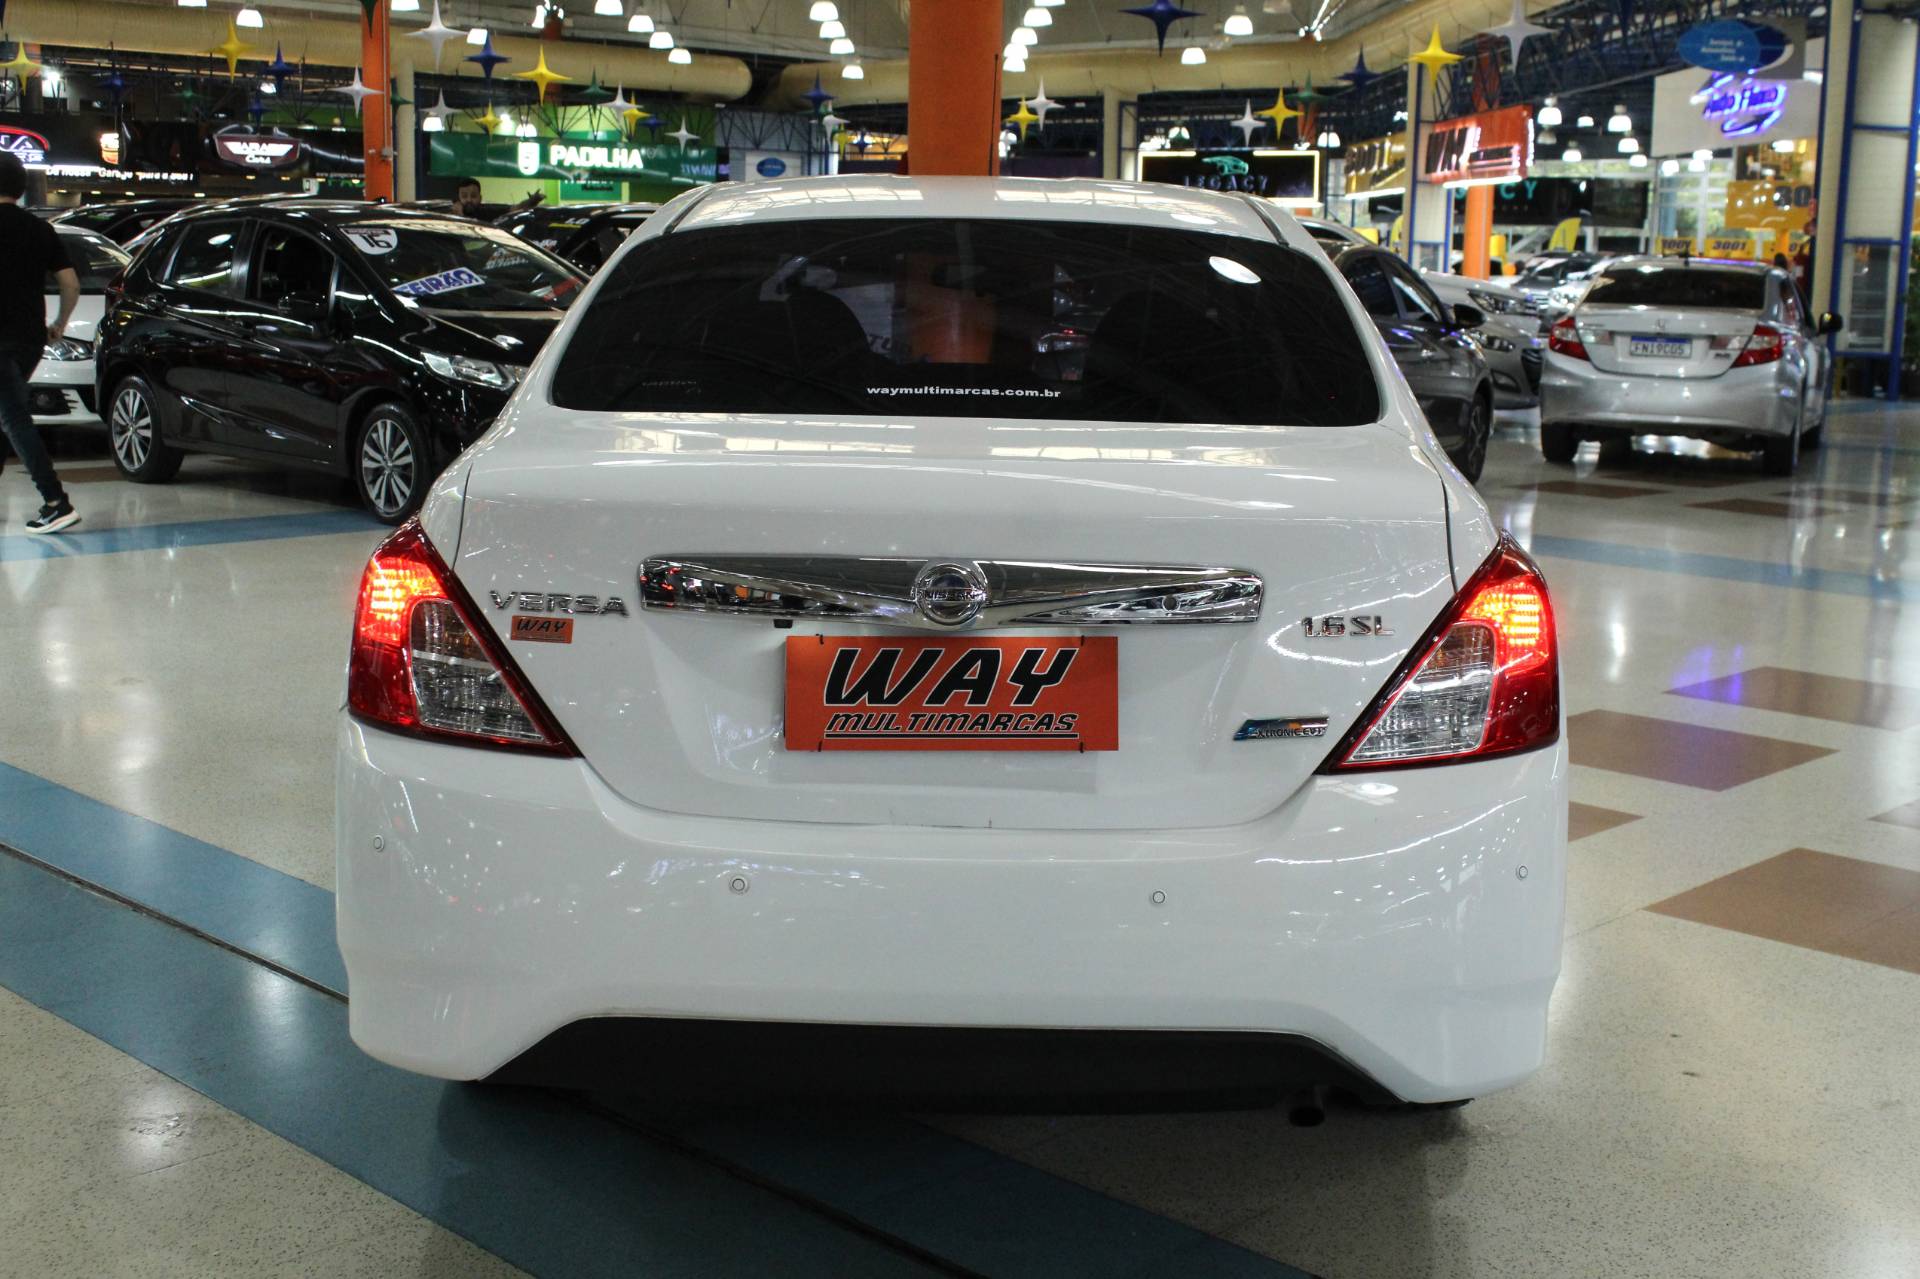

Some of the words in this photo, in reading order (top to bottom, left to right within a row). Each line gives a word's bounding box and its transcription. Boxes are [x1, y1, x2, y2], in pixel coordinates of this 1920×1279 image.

[550, 144, 644, 168] PADILHA
[1184, 175, 1268, 191] LEGACY
[1712, 241, 1748, 250] 3001
[867, 386, 1061, 398] waymultimarcas.com.br
[490, 590, 629, 616] VERSA
[516, 618, 567, 633] WAY
[1350, 615, 1395, 637] SL
[824, 647, 1079, 706] WAY
[825, 712, 1078, 731] MULTIMARCAS
